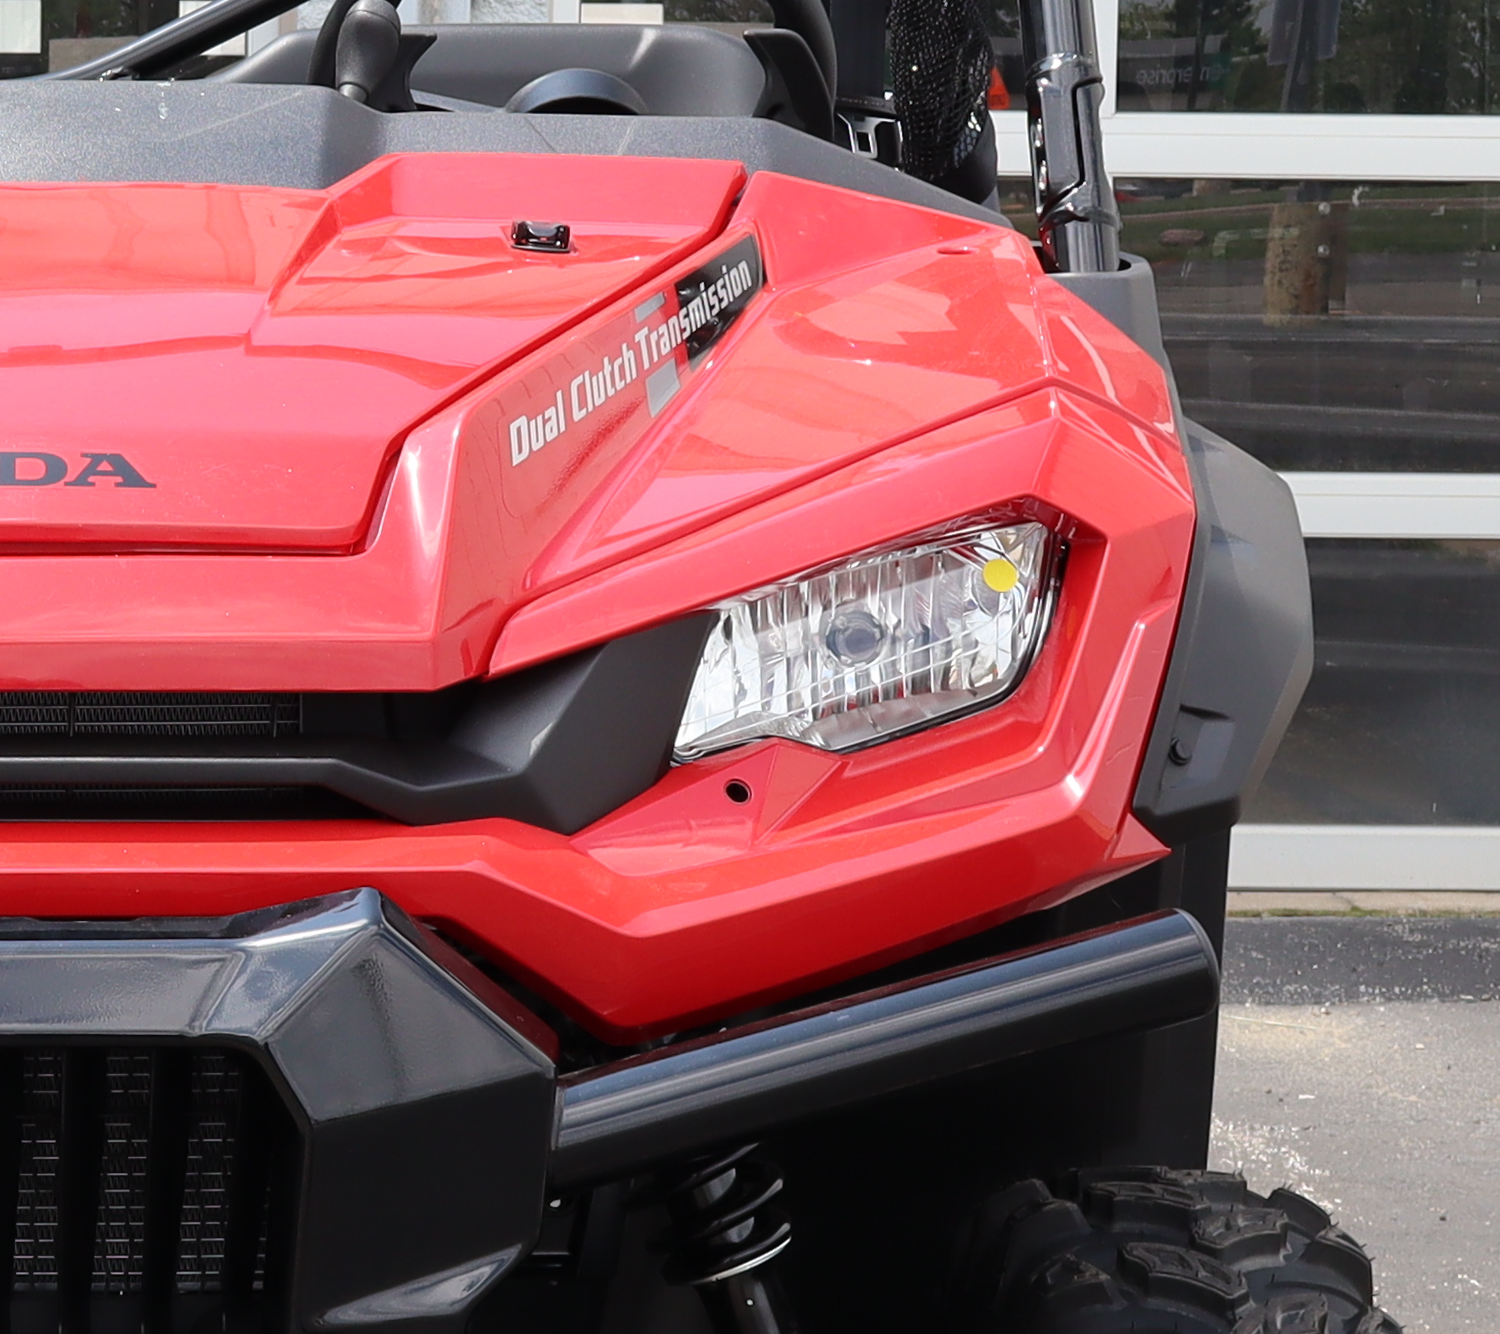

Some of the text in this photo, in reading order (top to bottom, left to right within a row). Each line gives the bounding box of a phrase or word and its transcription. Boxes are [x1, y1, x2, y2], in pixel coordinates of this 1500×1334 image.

[508, 259, 753, 468] Dual Clutch Transmission
